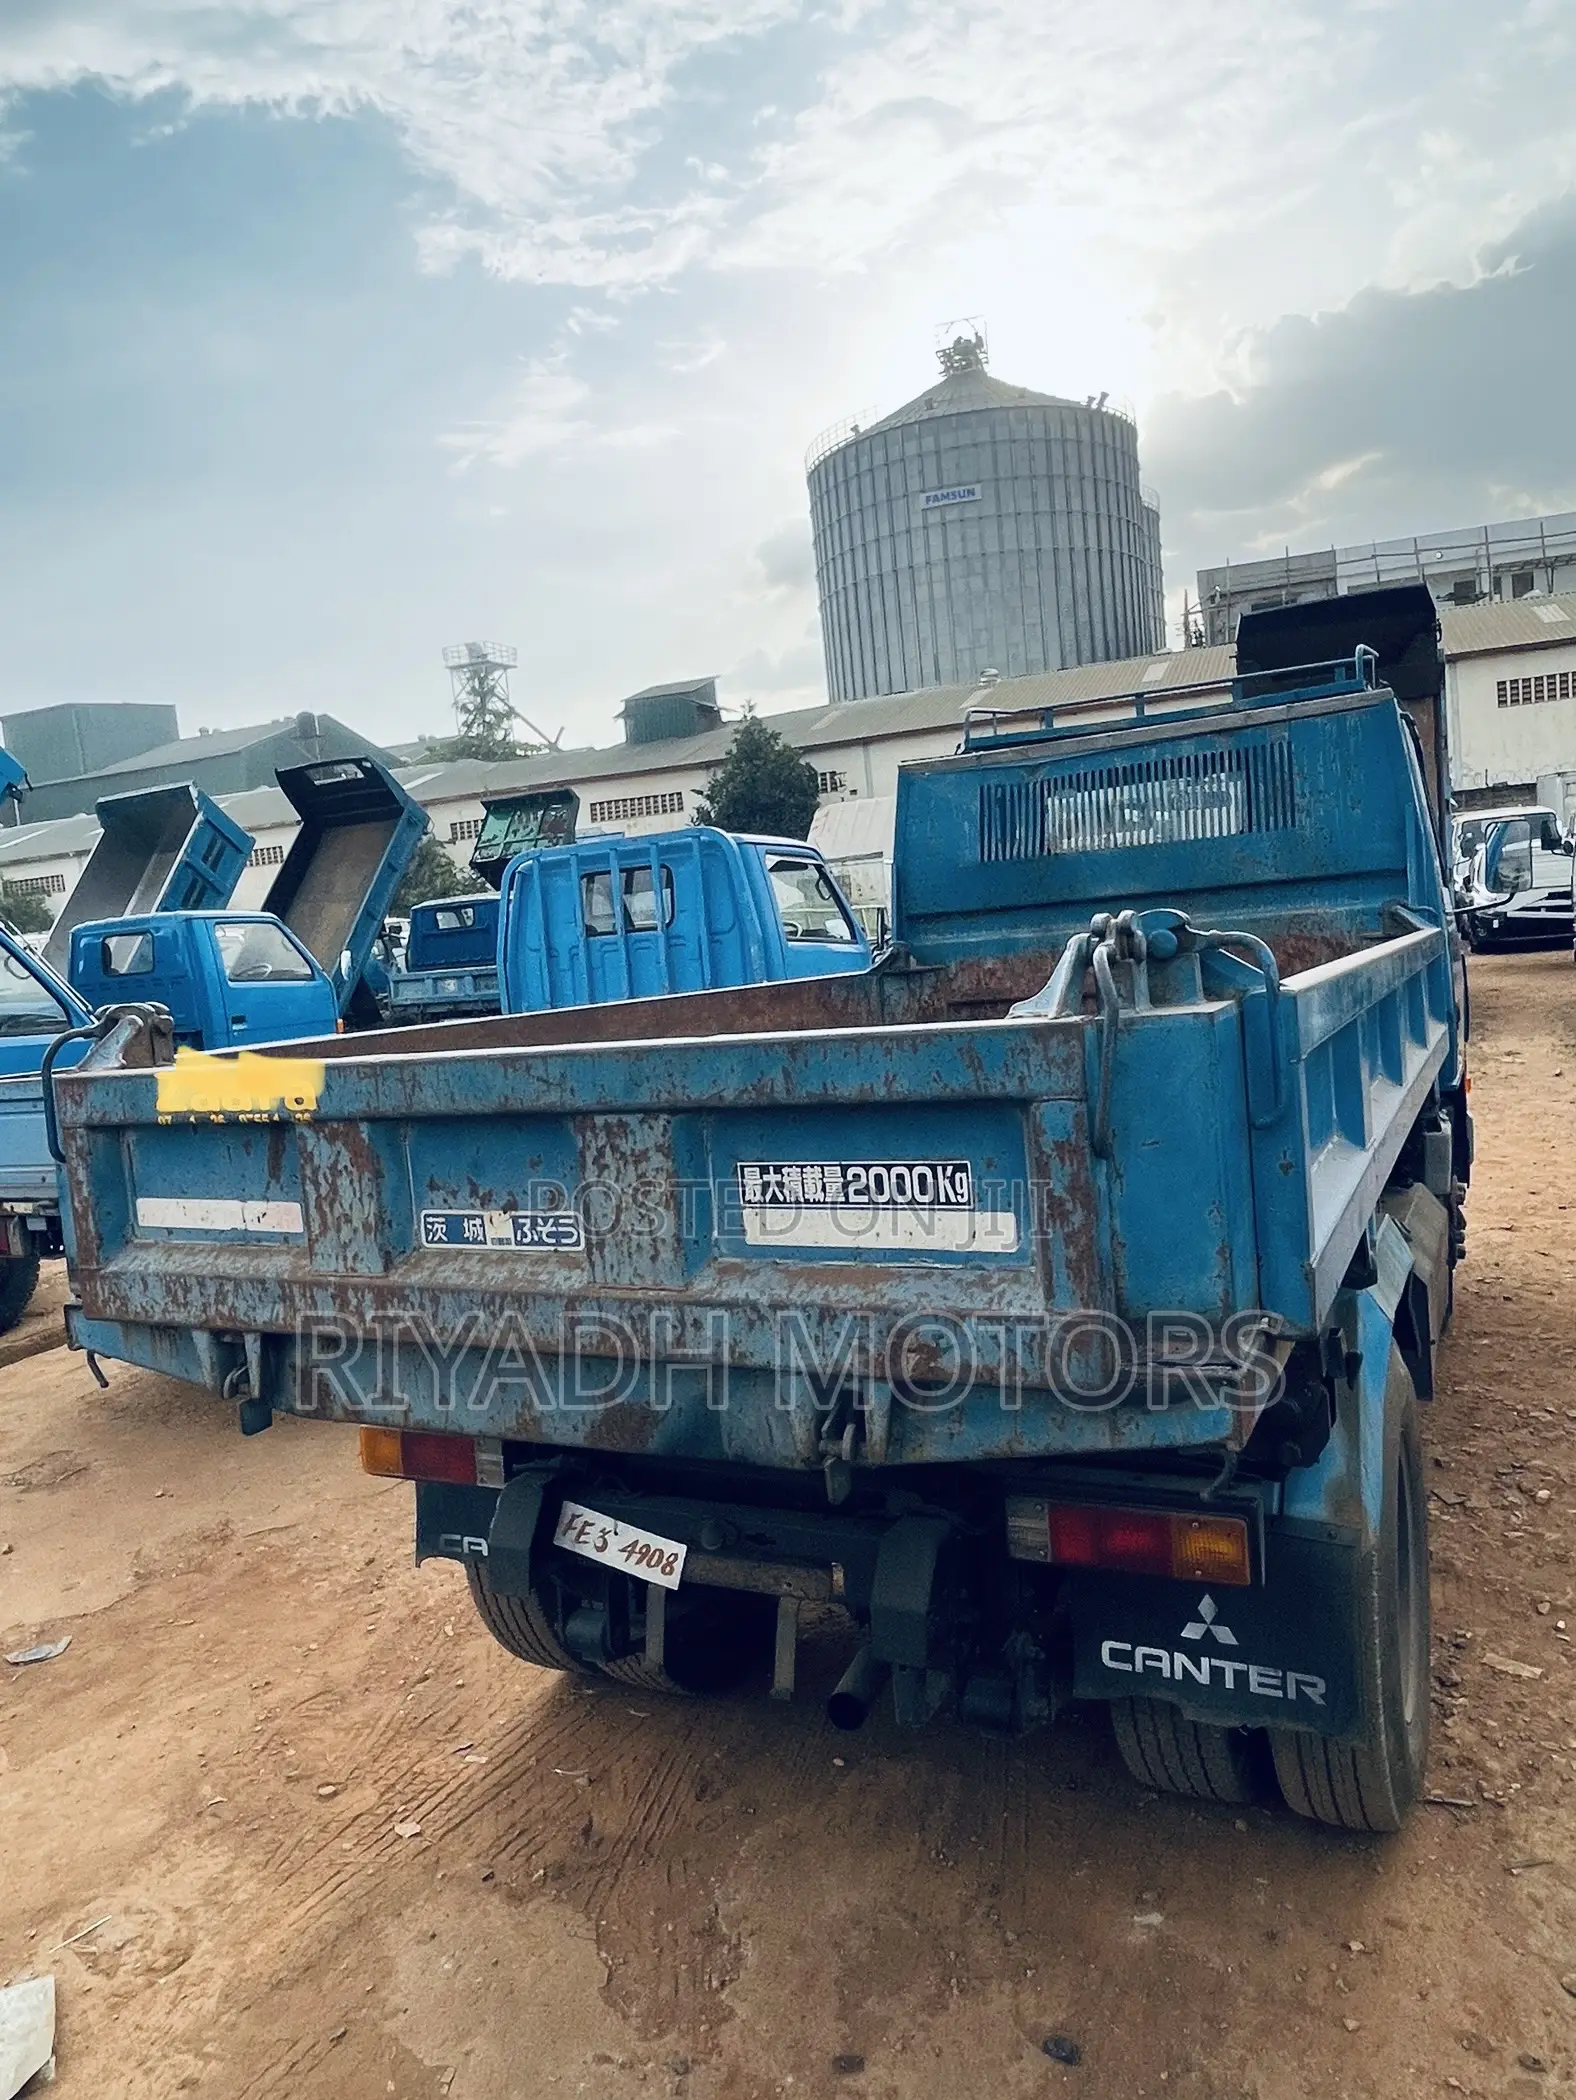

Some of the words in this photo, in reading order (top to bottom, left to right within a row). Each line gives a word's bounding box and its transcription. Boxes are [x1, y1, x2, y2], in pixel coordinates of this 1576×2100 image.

[925, 488, 976, 504] FAMSUN
[516, 1217, 579, 1244] ふそう
[618, 1539, 679, 1577] 4908
[1101, 1640, 1328, 1707] CANTER
